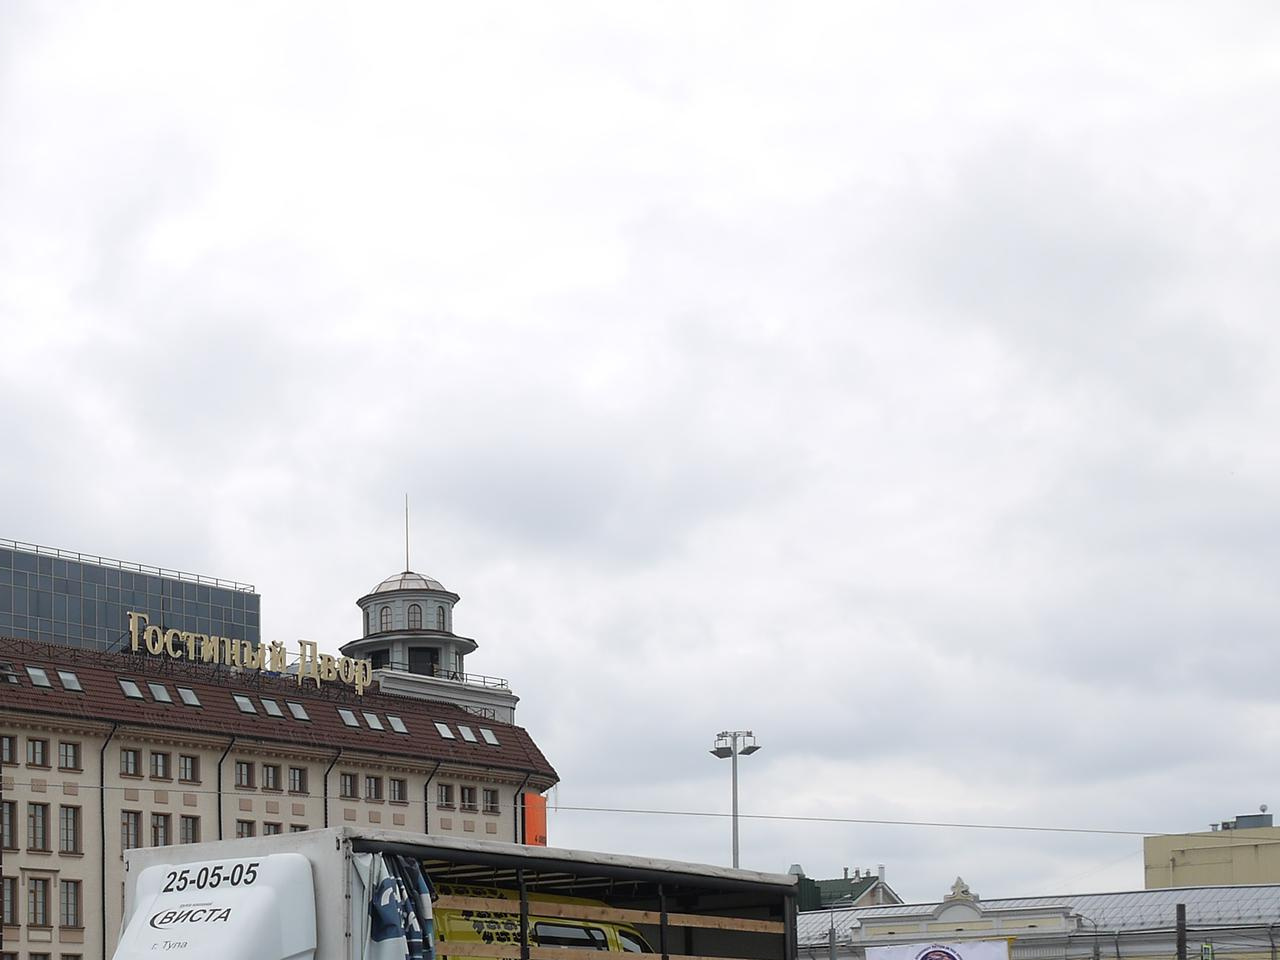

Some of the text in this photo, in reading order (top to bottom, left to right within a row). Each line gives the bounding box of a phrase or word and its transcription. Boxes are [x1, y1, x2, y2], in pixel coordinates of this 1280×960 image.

[127, 611, 372, 695] Гостиный Двор
[163, 863, 260, 893] 25-05-05
[156, 908, 232, 926] ВИСТА
[163, 940, 188, 951] Тула
